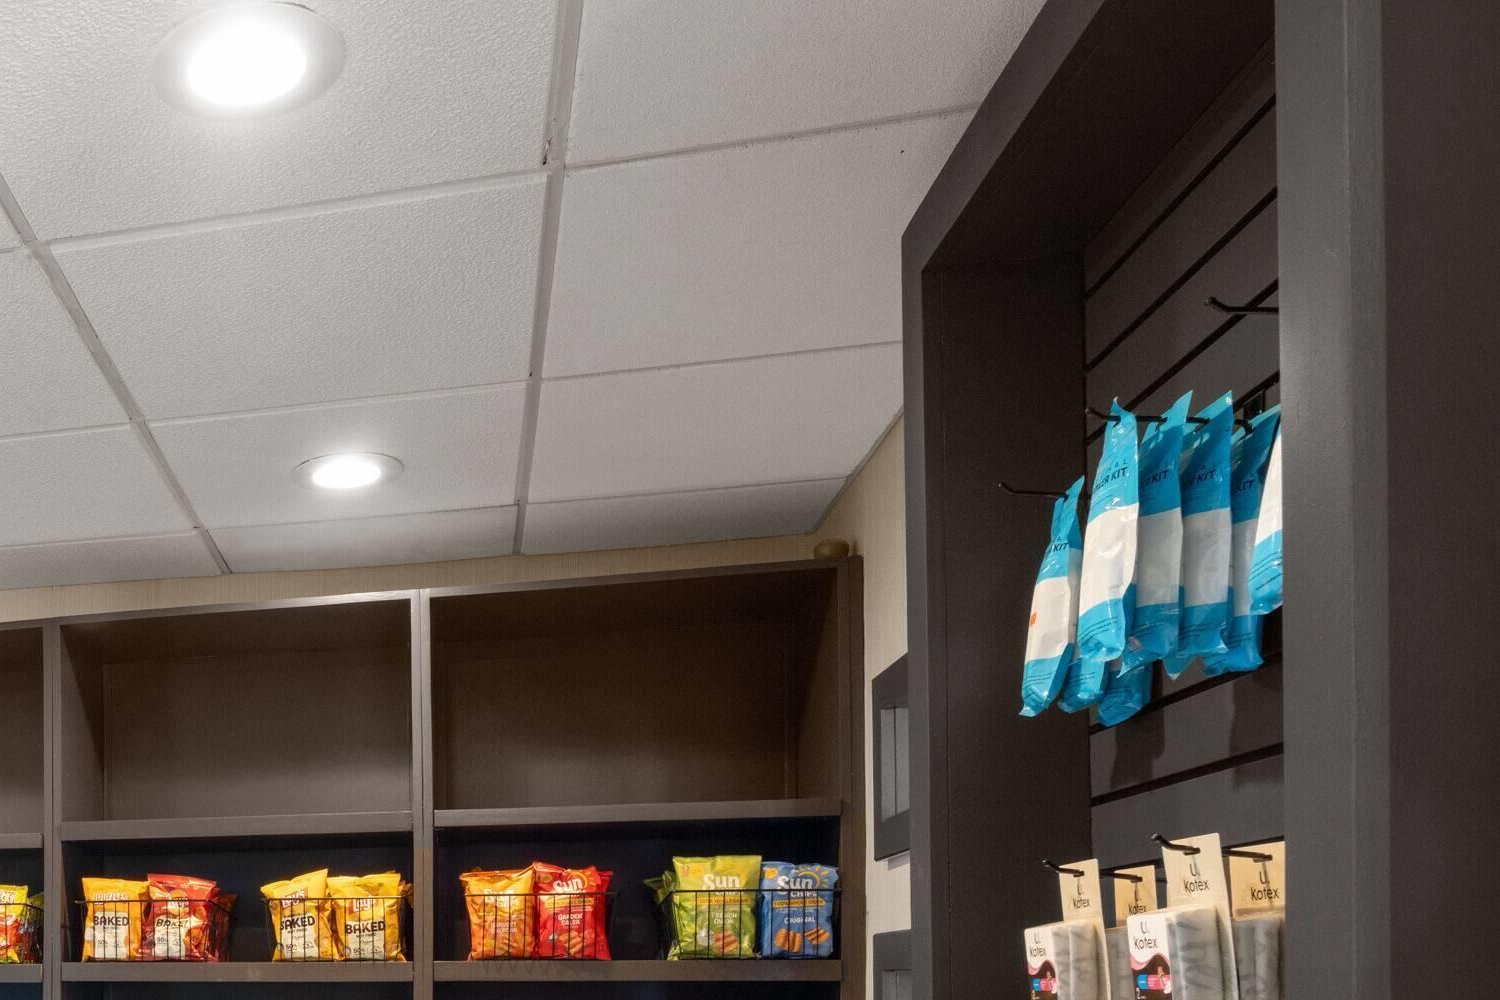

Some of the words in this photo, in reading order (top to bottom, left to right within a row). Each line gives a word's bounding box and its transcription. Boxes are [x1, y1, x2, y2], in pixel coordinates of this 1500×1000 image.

[553, 877, 584, 894] Sun
[703, 873, 741, 892] Sun
[776, 874, 814, 895] Sun
[1183, 879, 1210, 893] kotex
[1251, 887, 1280, 901] kotex
[93, 915, 130, 927] BAKED
[280, 915, 316, 931] BAKED
[345, 920, 386, 935] BAKED
[1134, 937, 1157, 950] kotex
